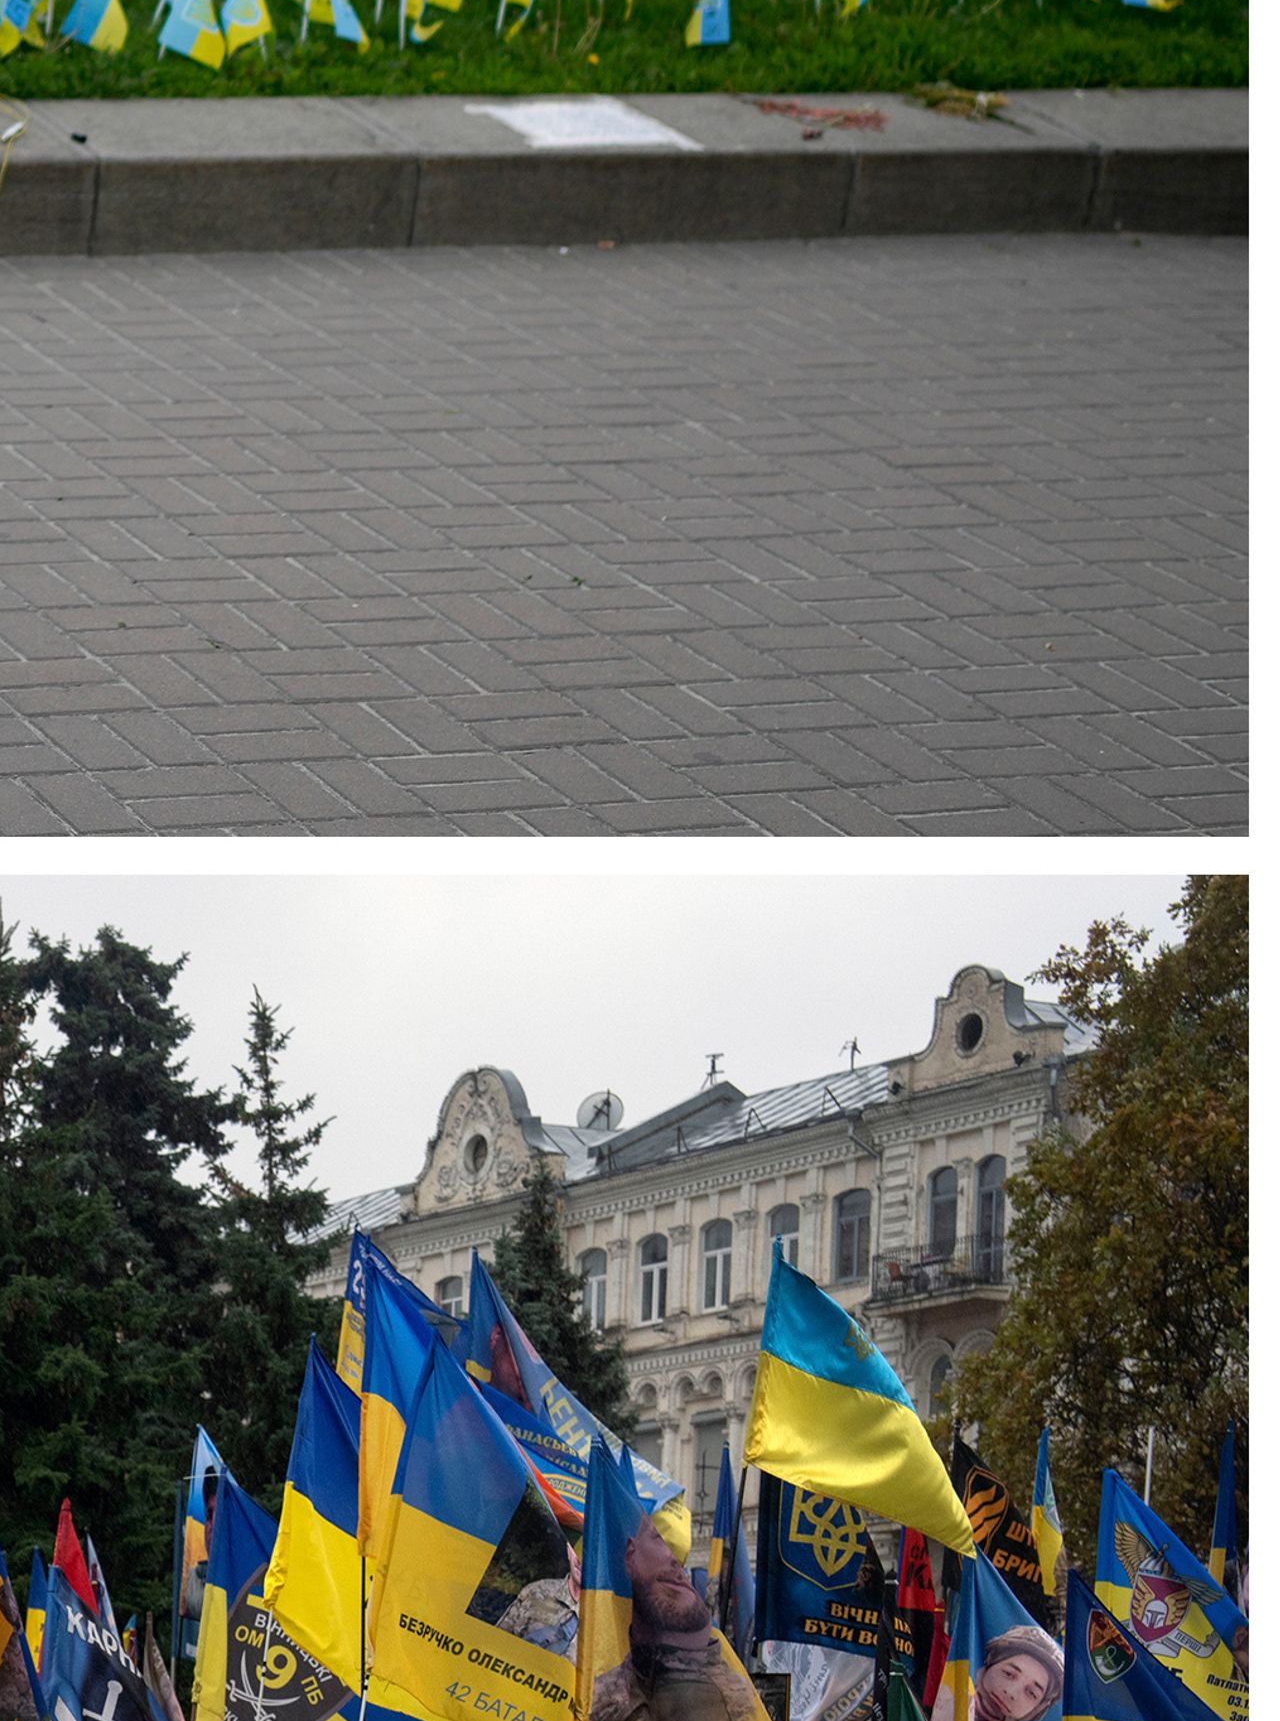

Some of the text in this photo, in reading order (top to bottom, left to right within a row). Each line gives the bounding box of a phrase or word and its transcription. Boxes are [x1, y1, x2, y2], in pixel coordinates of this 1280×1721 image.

[235, 1625, 324, 1706] ОМ 9 ПБ
[399, 1613, 569, 1703] БЕЗРУЧКО ОЛЕКСАНДР
[445, 1681, 471, 1703] 42
